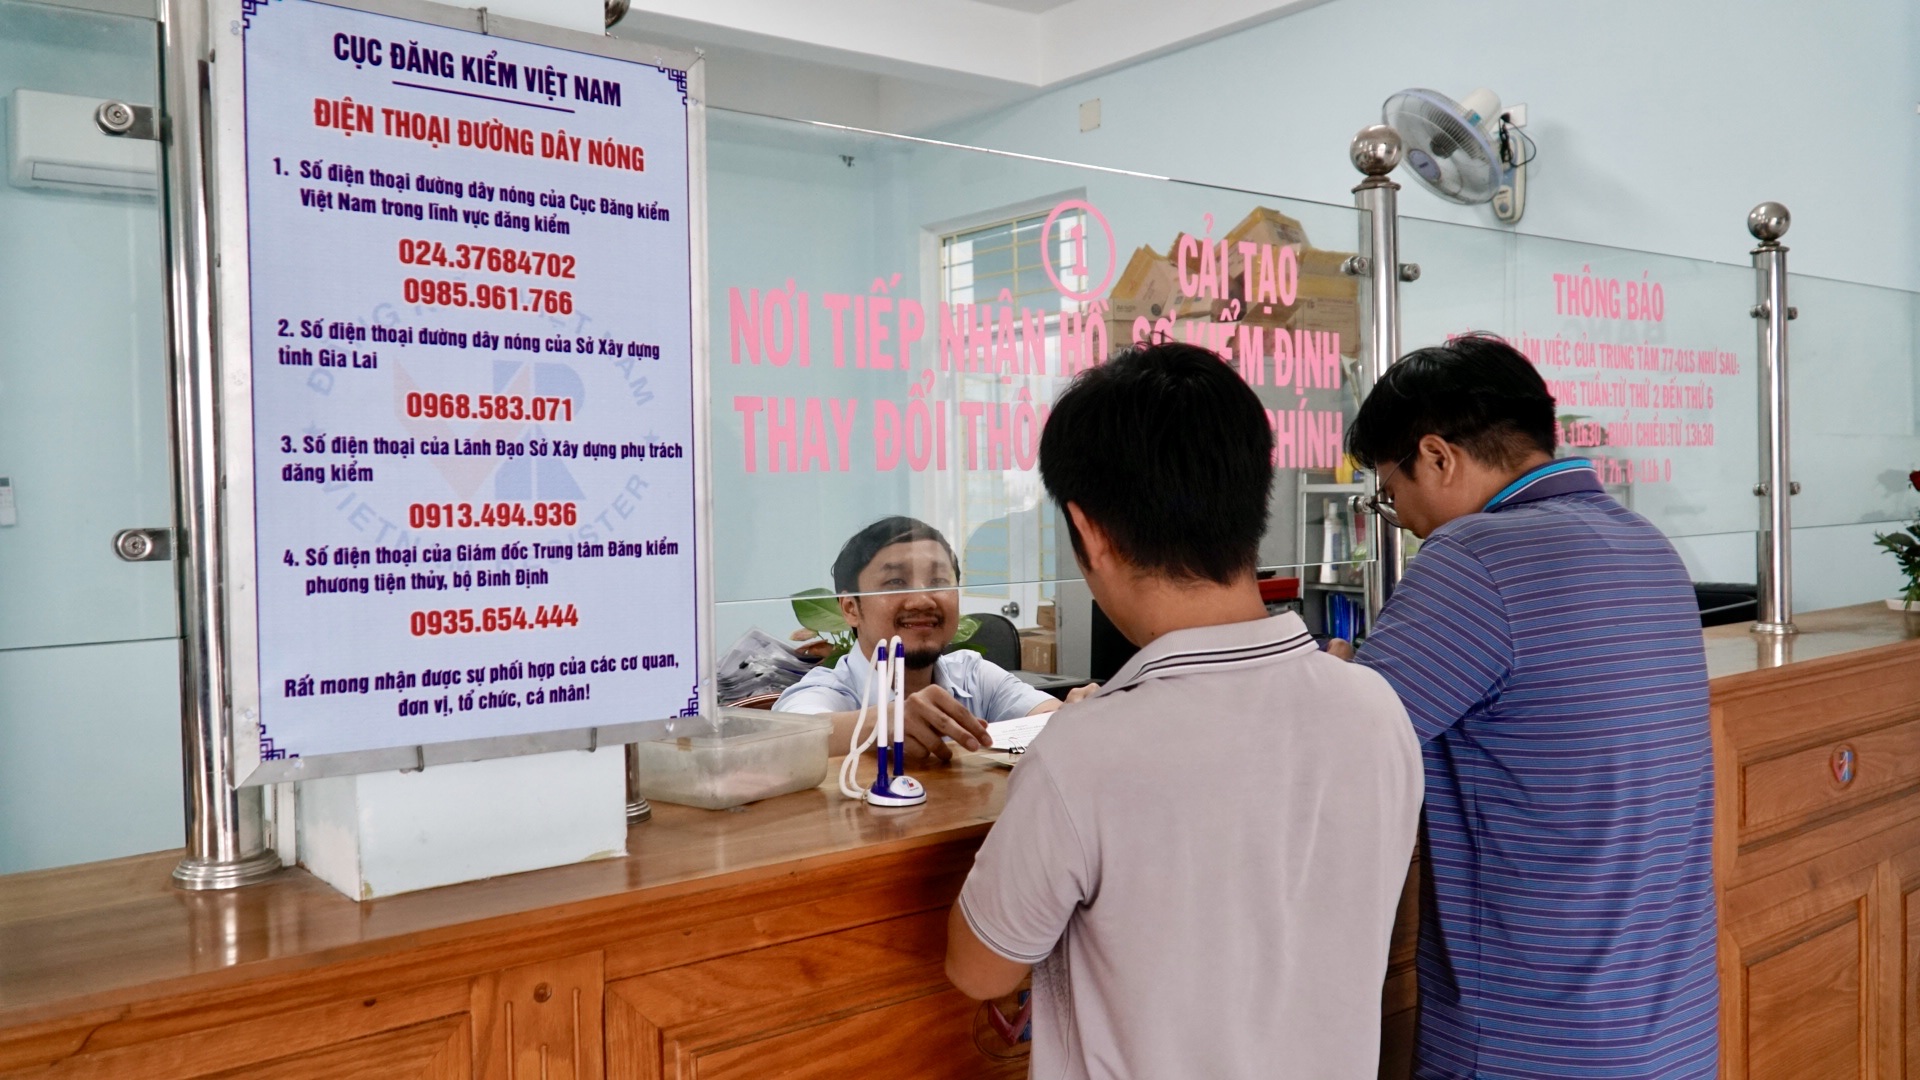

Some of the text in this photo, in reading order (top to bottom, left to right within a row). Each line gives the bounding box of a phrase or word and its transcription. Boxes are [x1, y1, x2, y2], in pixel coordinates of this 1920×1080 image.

[334, 33, 621, 107] CỤC ĐĂNG KIỂM VIỆT NAM
[314, 97, 643, 171] ĐIỆN THOẠI ĐƯỜNG DÂY NÓNG
[274, 158, 669, 221] 1. Số điện thoại đường dây nóng của Cục Đăng kiểm
[300, 188, 569, 234] Việt Nam trong lĩnh vực đăng kiểm
[399, 239, 575, 278] 024.37684702
[1071, 225, 1087, 275] 1
[1178, 213, 1298, 315] CẢI TẠO
[404, 278, 572, 314] 0985.961.766
[1553, 264, 1664, 322] THÔNG BÁO
[278, 318, 659, 360] 2. Số điện thoại đường dây nóng của Sở Xây dựng
[730, 279, 809, 366] NƠI
[824, 274, 924, 369] TIẾP
[940, 289, 1045, 384] NHẬN
[1060, 299, 1109, 376] HỒ
[1274, 328, 1341, 395] ĐỊNH
[1544, 333, 1571, 371] VIỆC
[1574, 334, 1596, 368] CỦA
[1600, 344, 1635, 370] TRUNG
[1637, 341, 1659, 371] TÂM
[1698, 347, 1718, 375] NHƯ
[1719, 353, 1739, 375] SAU:
[279, 345, 377, 368] tỉnh Gia Lai
[407, 393, 571, 421] 0968.583.071
[1629, 377, 1649, 409] THỨ
[1653, 386, 1660, 409] 2
[1662, 376, 1683, 410] ĐẾN
[1684, 379, 1705, 409] THỨ
[1706, 387, 1713, 409] 6
[734, 397, 856, 472] THAY
[874, 370, 946, 471] ĐỔI
[1686, 424, 1714, 446] 13h30
[281, 434, 682, 461] 3. Số điện thoại của Lãnh Đạo Sở Xây dựng phụ trách
[282, 461, 373, 483] đăng kiểm
[410, 503, 576, 528] 0913.494.936
[284, 536, 678, 568] 4. Số điện thoại của Giám đốc Trung tâm Đăng kiểm
[306, 569, 548, 596] phương tiện thủy, bộ Bình Định
[411, 604, 578, 636] 0935.654.444
[285, 654, 678, 697] Rất mong nhận được sự phối hợp của các cơ quan,
[399, 684, 589, 716] đơn vị, tổ chức, cá nhân!
